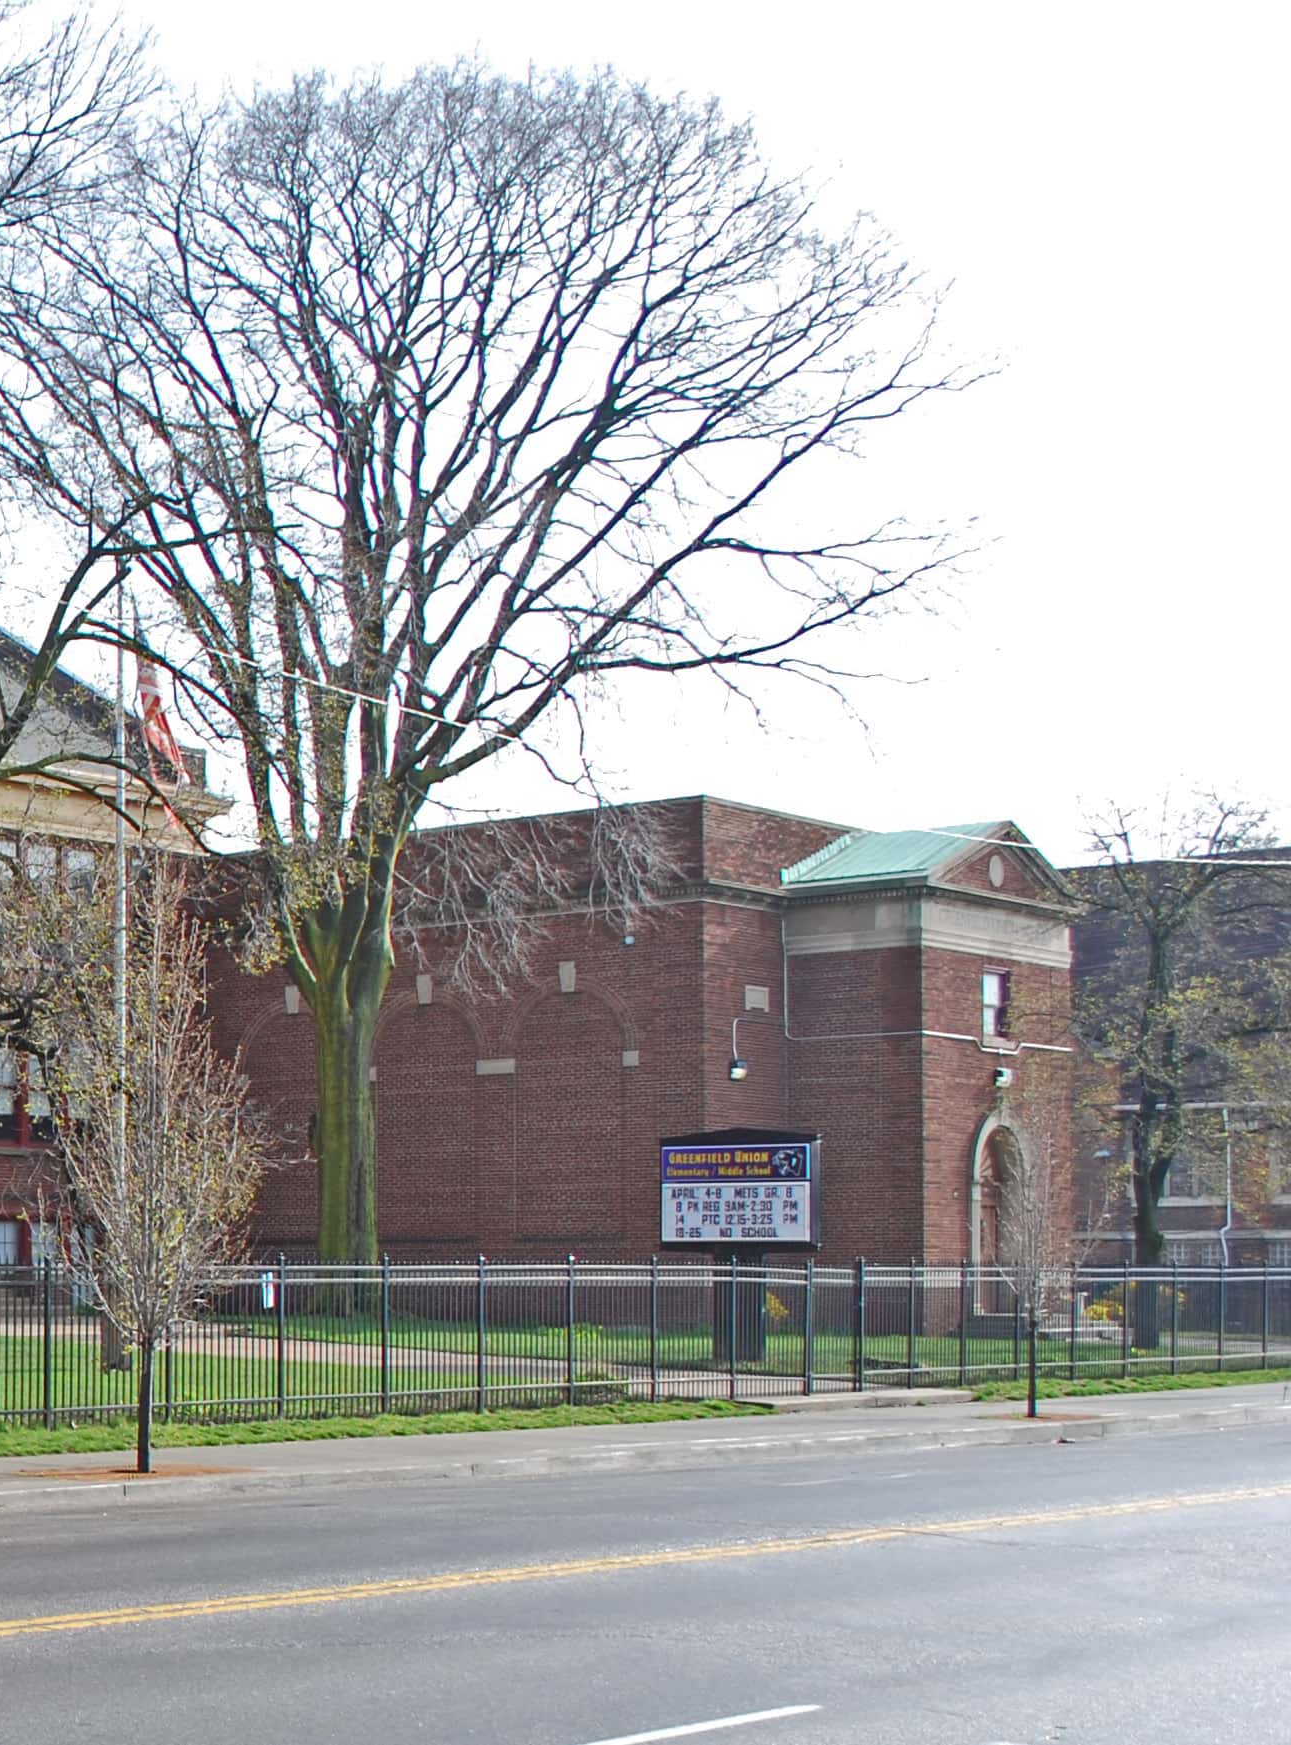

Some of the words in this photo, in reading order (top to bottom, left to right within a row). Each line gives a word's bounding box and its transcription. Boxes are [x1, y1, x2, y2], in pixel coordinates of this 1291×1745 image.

[666, 1167, 709, 1177] Elementary
[718, 1166, 744, 1177] Middle
[746, 1164, 771, 1176] School
[704, 1188, 722, 1199] 4-8
[785, 1187, 792, 1198] 8
[782, 1200, 798, 1211] PM
[701, 1214, 720, 1225] PTC
[782, 1213, 798, 1224] PM
[719, 1227, 732, 1238] NO
[740, 1227, 778, 1238] SCHOOL
